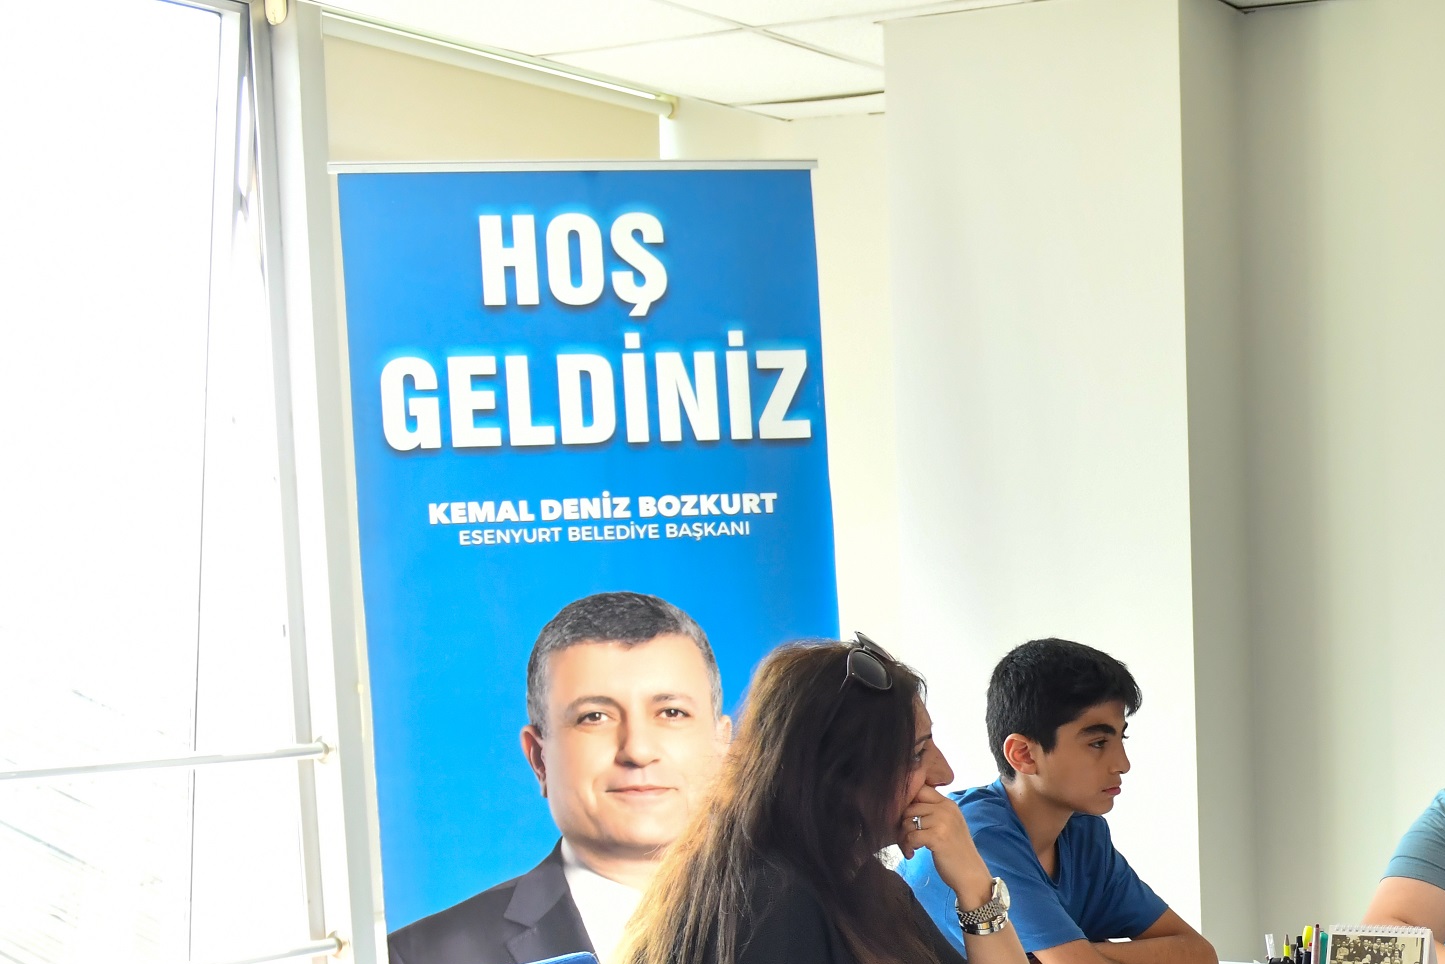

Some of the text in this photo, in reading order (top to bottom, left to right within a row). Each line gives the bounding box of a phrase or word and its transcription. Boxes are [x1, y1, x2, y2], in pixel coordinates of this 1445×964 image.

[479, 212, 669, 317] HOŞ
[380, 330, 812, 451] GELDİNİZ
[429, 491, 776, 524] KEMAL DENİZ BOZKURT
[460, 522, 749, 545] ESENYURT BELEDİYE BAŞKANI
